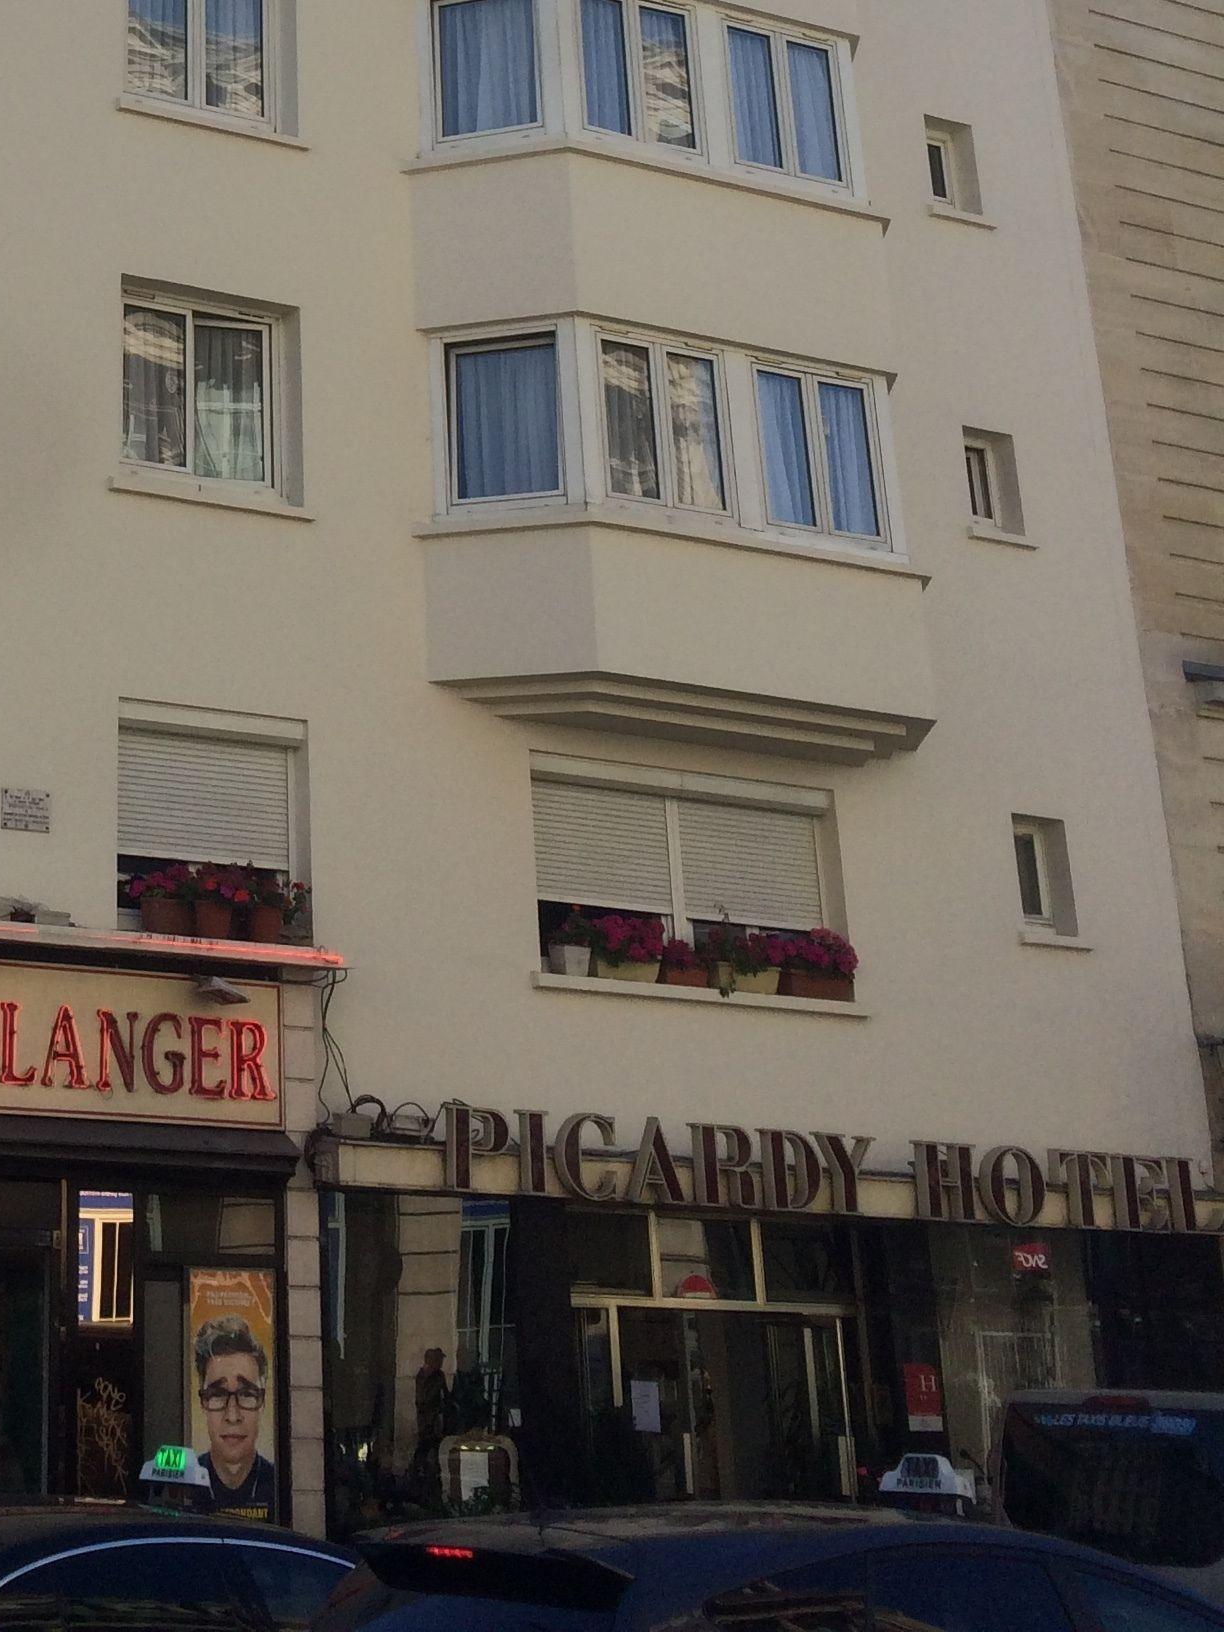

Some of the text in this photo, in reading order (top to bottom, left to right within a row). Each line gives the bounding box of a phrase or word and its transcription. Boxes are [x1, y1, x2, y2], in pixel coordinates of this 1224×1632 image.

[444, 1103, 1223, 1235] PICARDY HOTEL
[918, 1374, 938, 1393] H
[159, 1449, 183, 1469] TAXI
[896, 1478, 942, 1490] PARISIEN
